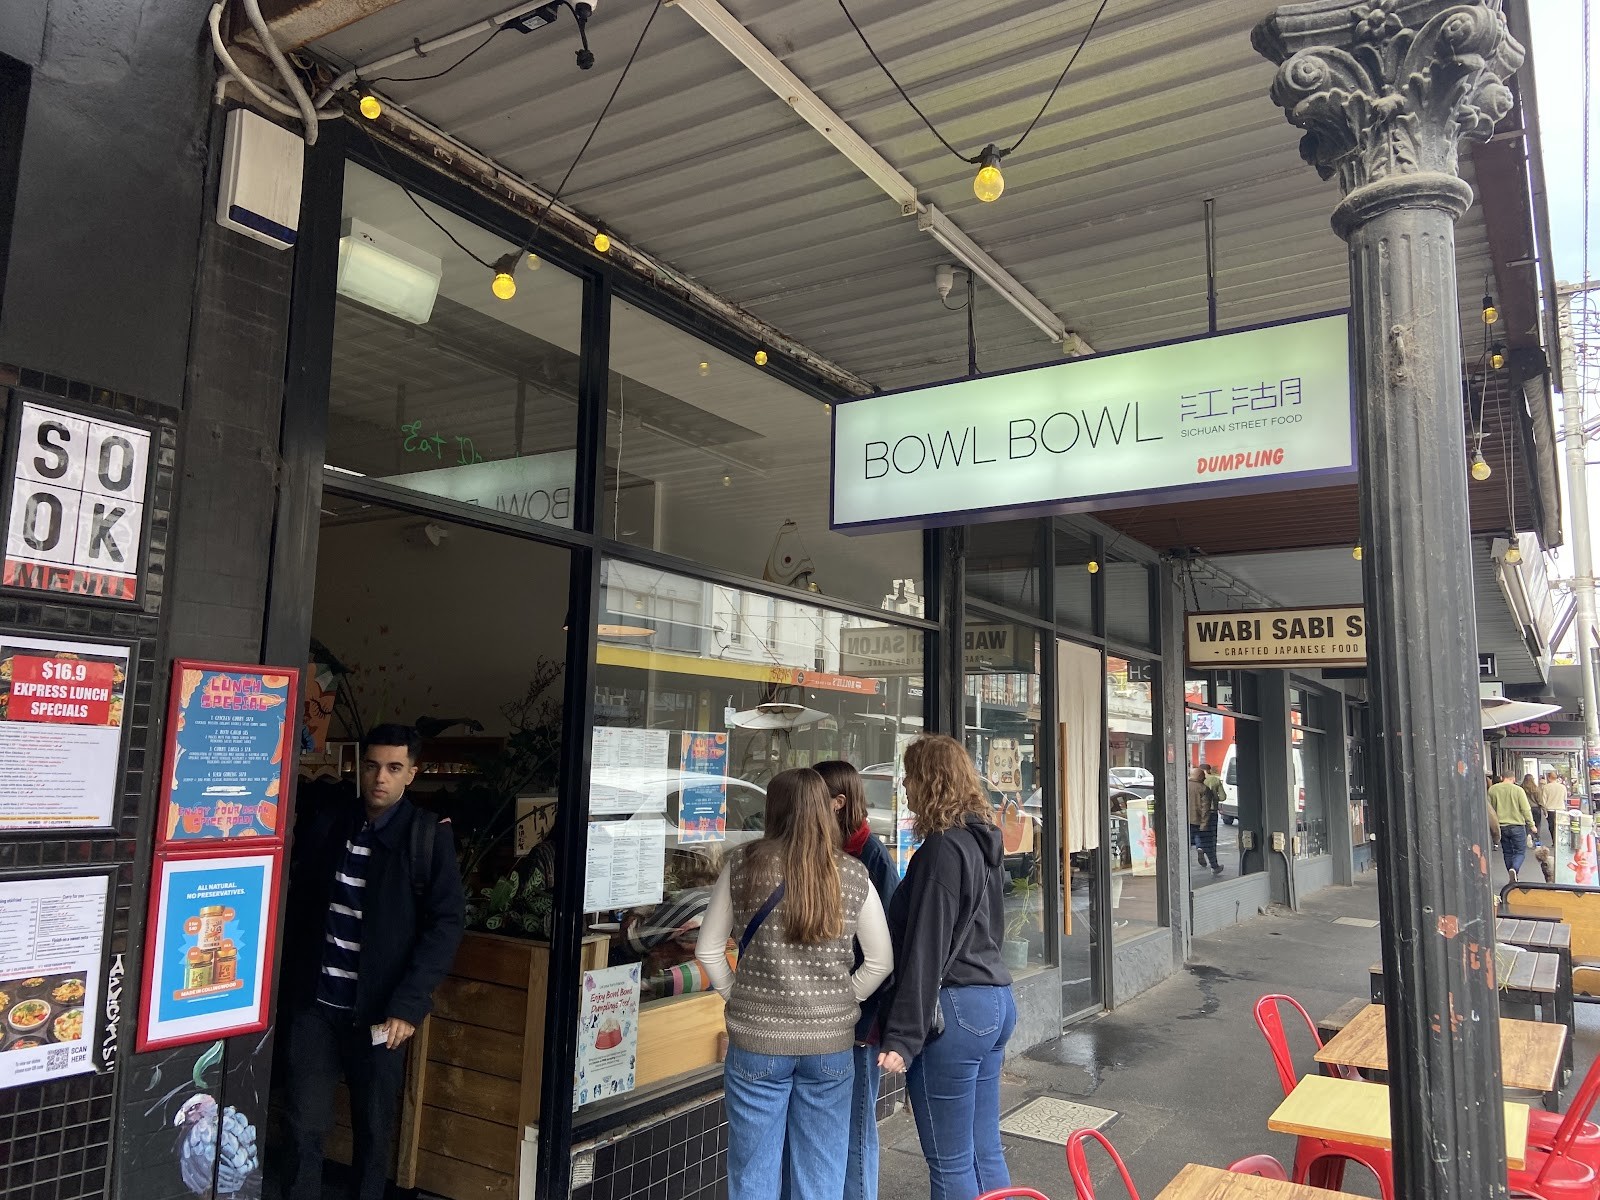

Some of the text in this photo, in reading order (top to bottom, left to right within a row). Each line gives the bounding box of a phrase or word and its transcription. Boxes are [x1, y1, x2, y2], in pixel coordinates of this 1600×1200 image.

[1181, 377, 1302, 422] 江湖
[1180, 413, 1303, 438] SICHUAN STREET FOOD
[401, 420, 447, 460] Eat
[865, 401, 1164, 480] BOWL BOWL
[1196, 447, 1285, 475] DUMPLING
[13, 563, 125, 597] MENU
[1196, 619, 1261, 642] WABI
[1272, 616, 1334, 640] SABI
[1225, 643, 1359, 656] CRAFTED JAPANESE FOOD
[42, 660, 87, 682] $16.9
[13, 682, 109, 702] EXPRESS LUNCH
[211, 677, 262, 694] LUNCH
[31, 701, 89, 718] SPECIALS
[201, 694, 268, 712] SPECIAL
[1508, 722, 1551, 735] Shag
[178, 806, 211, 816] ENJOY
[215, 805, 240, 815] YOUR
[193, 816, 223, 826] SPICE
[181, 988, 195, 997] MADE
[202, 982, 237, 993] COLLINGWOOD
[590, 987, 633, 1004] Enjoy Bowl Bowl
[591, 1002, 619, 1014] Dumplings
[71, 1045, 88, 1055] SCAN
[71, 1054, 87, 1063] HERE
